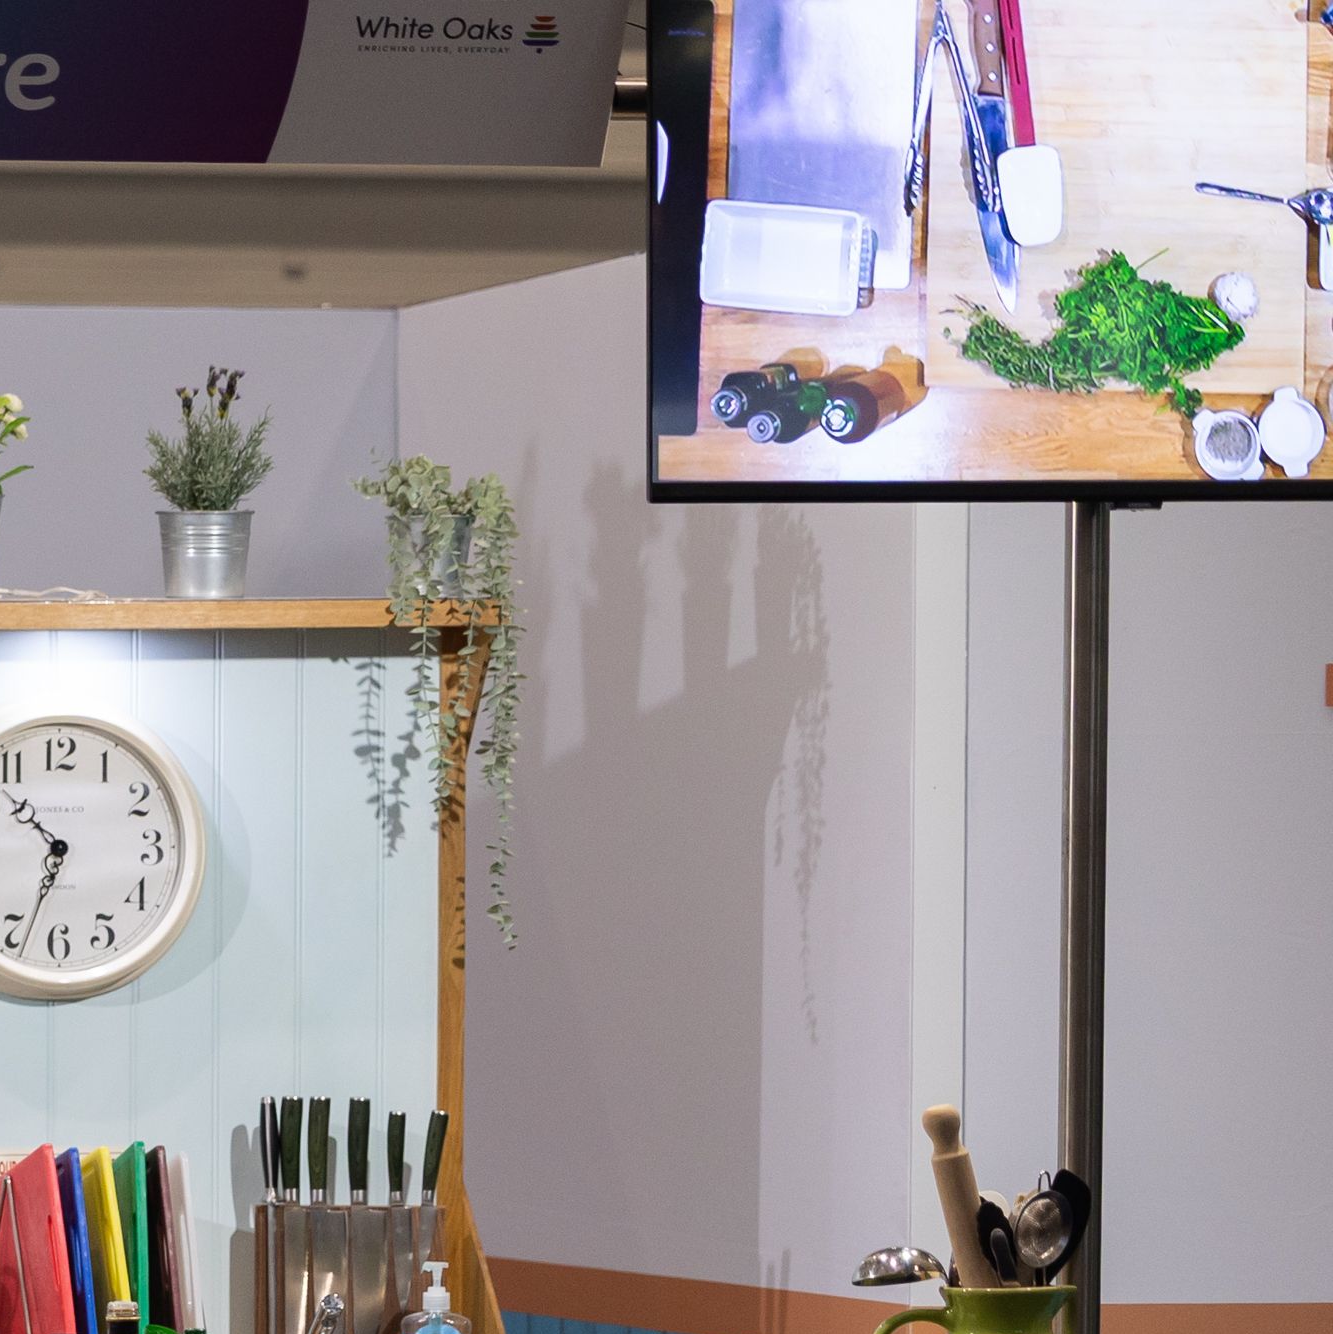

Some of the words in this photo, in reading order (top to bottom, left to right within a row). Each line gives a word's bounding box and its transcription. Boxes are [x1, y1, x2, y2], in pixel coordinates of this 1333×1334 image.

[356, 16, 433, 39] White
[443, 17, 513, 40] Oaks
[358, 45, 415, 53] ENRICHING
[457, 46, 509, 54] EVERYDAY
[1, 750, 22, 784] 11
[45, 736, 76, 771] 12
[101, 750, 108, 783] 1
[127, 782, 150, 817] 2
[140, 829, 164, 865] 3
[124, 876, 145, 911] 4
[4, 913, 24, 949] 7
[47, 923, 70, 960] 6
[90, 913, 115, 950] 5
